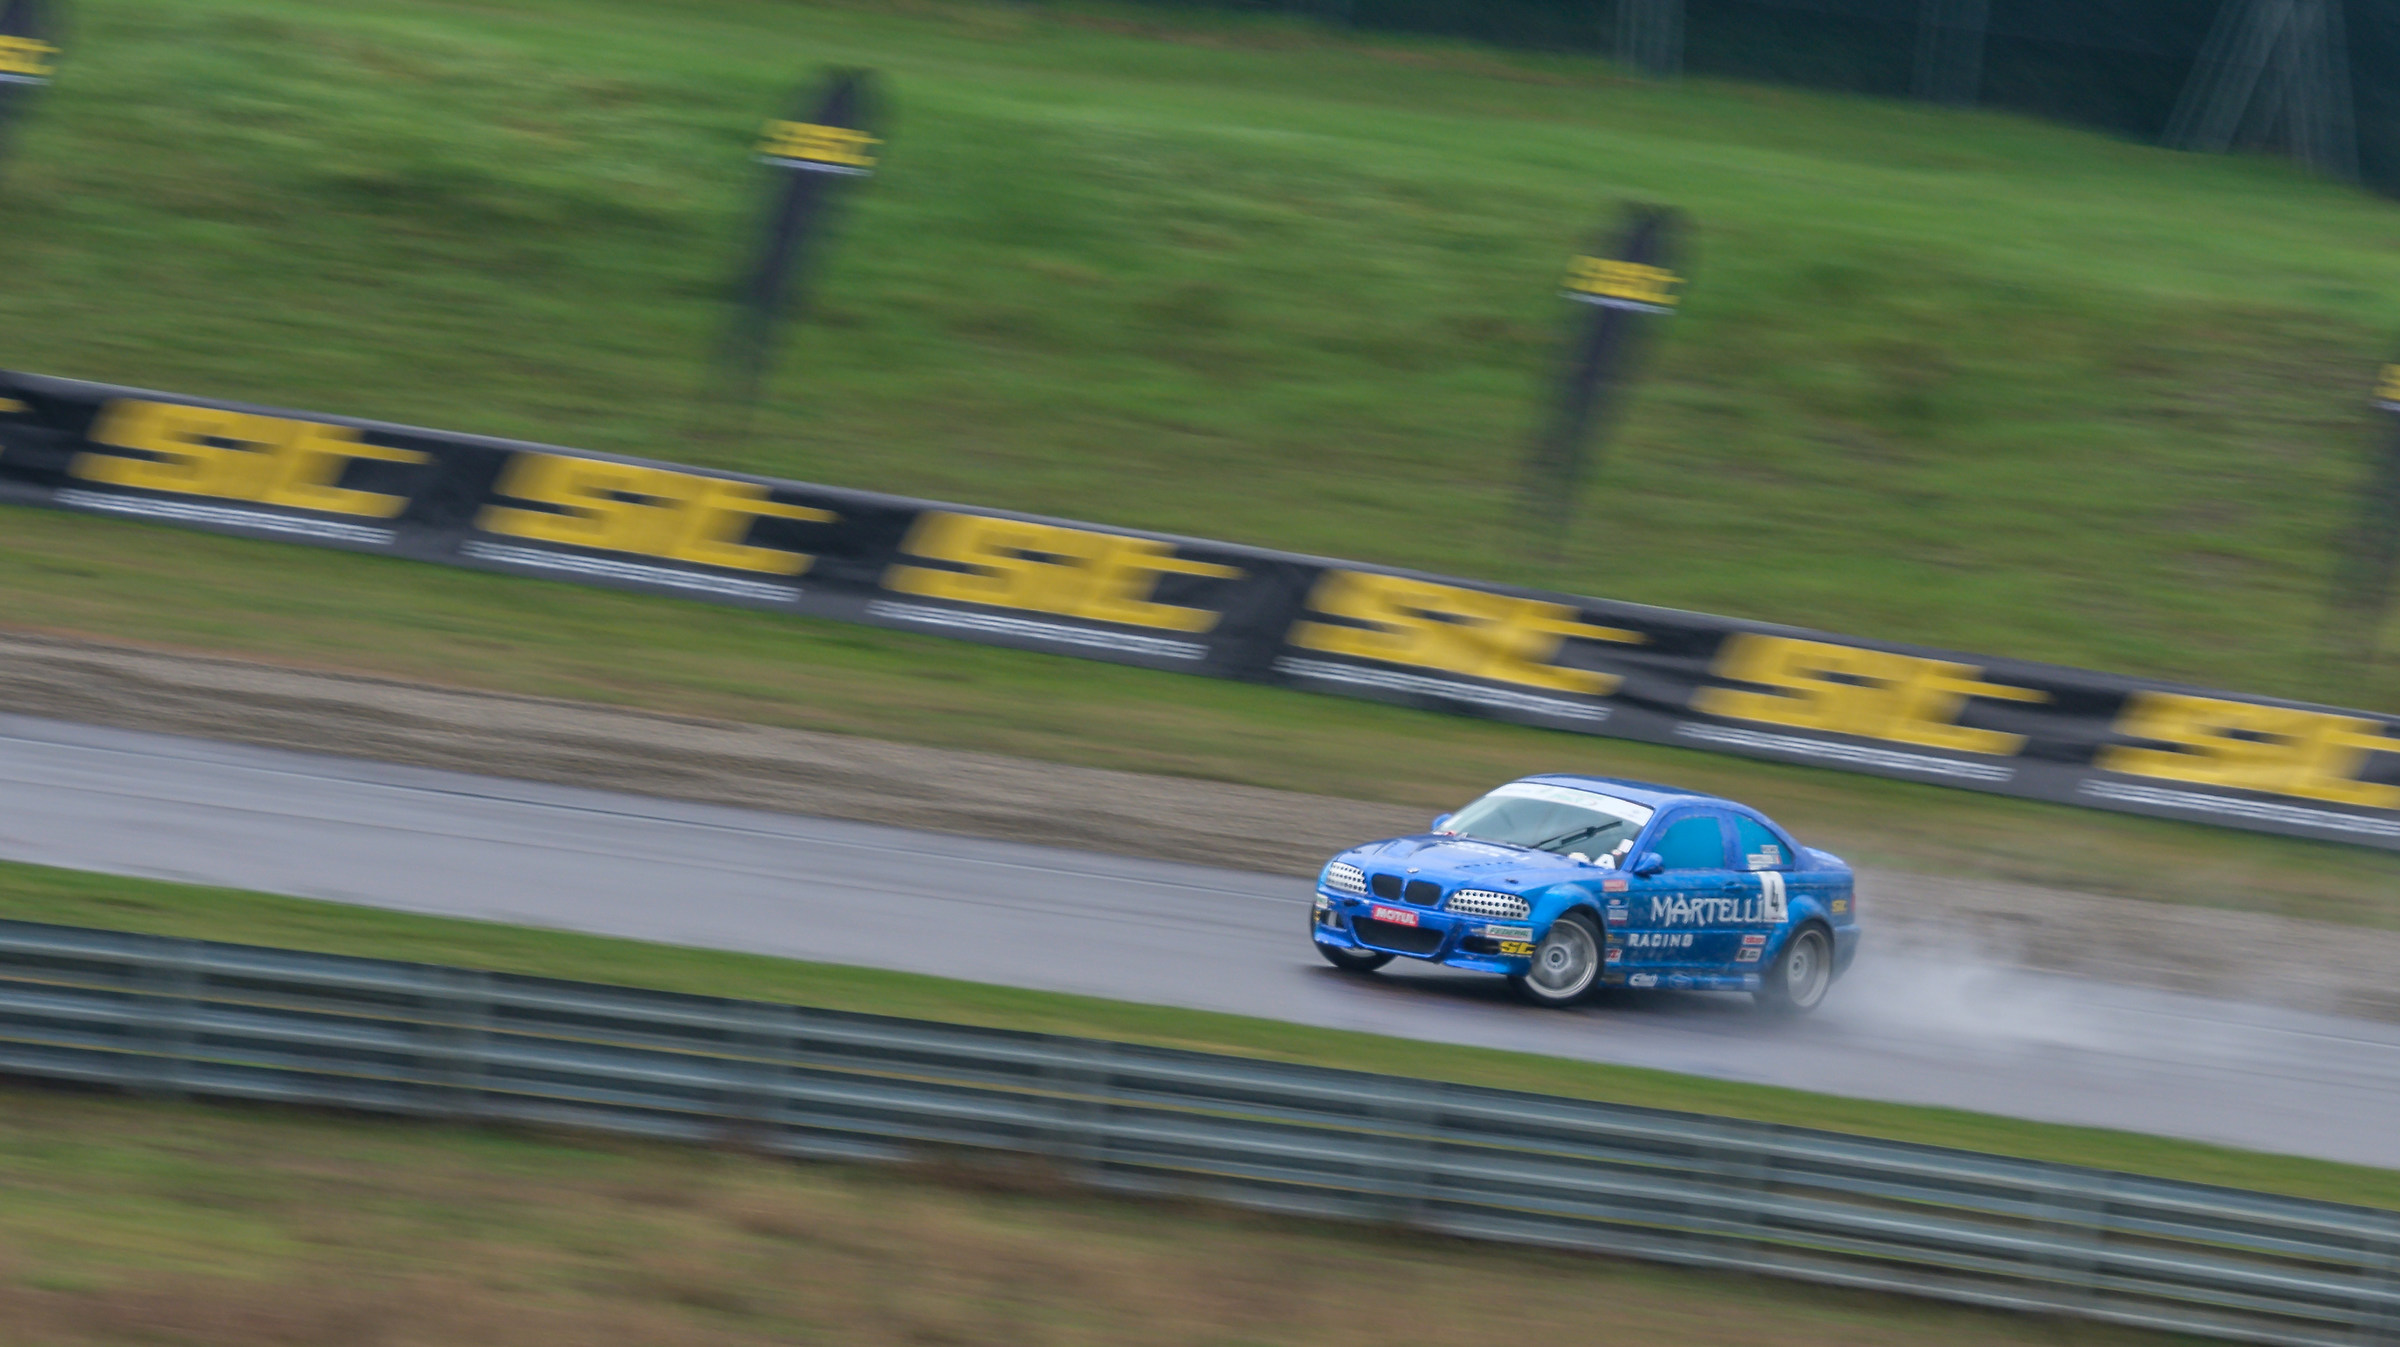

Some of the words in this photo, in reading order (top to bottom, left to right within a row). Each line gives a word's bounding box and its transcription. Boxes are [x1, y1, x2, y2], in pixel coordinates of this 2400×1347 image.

[1769, 879, 1781, 913] 4
[1375, 906, 1416, 925] MOTUL
[1628, 932, 1694, 948] RACING
